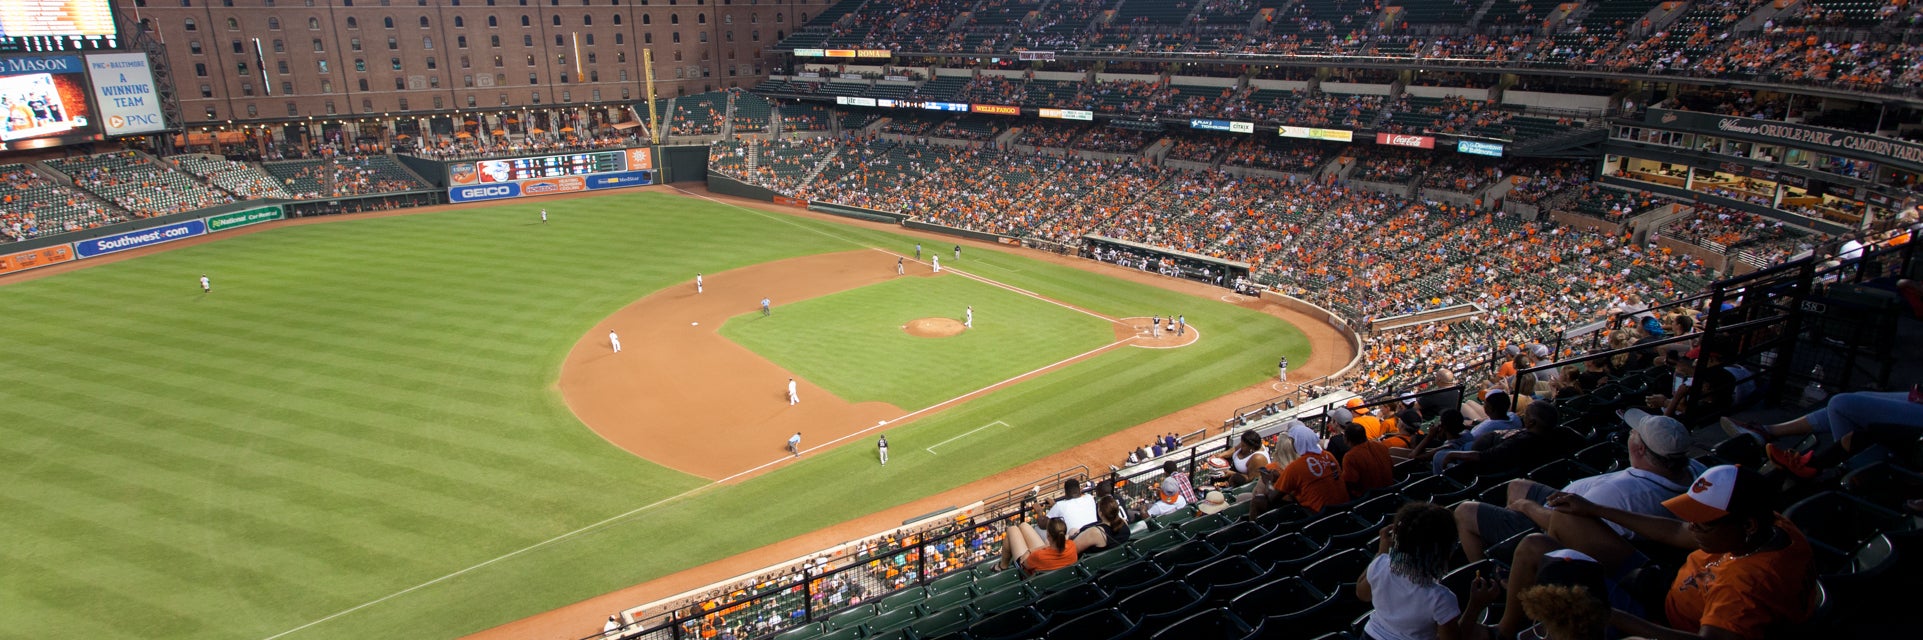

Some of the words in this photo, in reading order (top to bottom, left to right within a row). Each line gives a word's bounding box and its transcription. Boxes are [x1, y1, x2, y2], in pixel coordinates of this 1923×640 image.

[8, 58, 68, 72] MASON
[120, 73, 127, 83] A
[101, 83, 149, 97] WINNING
[113, 96, 144, 108] TEAM
[976, 105, 996, 113] WELLS
[125, 113, 159, 127] PNC
[1718, 118, 1751, 133] Welcome
[1751, 126, 1759, 134] to
[1759, 123, 1802, 141] ORIOLE
[1802, 129, 1833, 146] PARK
[1843, 136, 1893, 156] CAMDEN
[462, 186, 510, 199] GEICO
[220, 215, 247, 226] National
